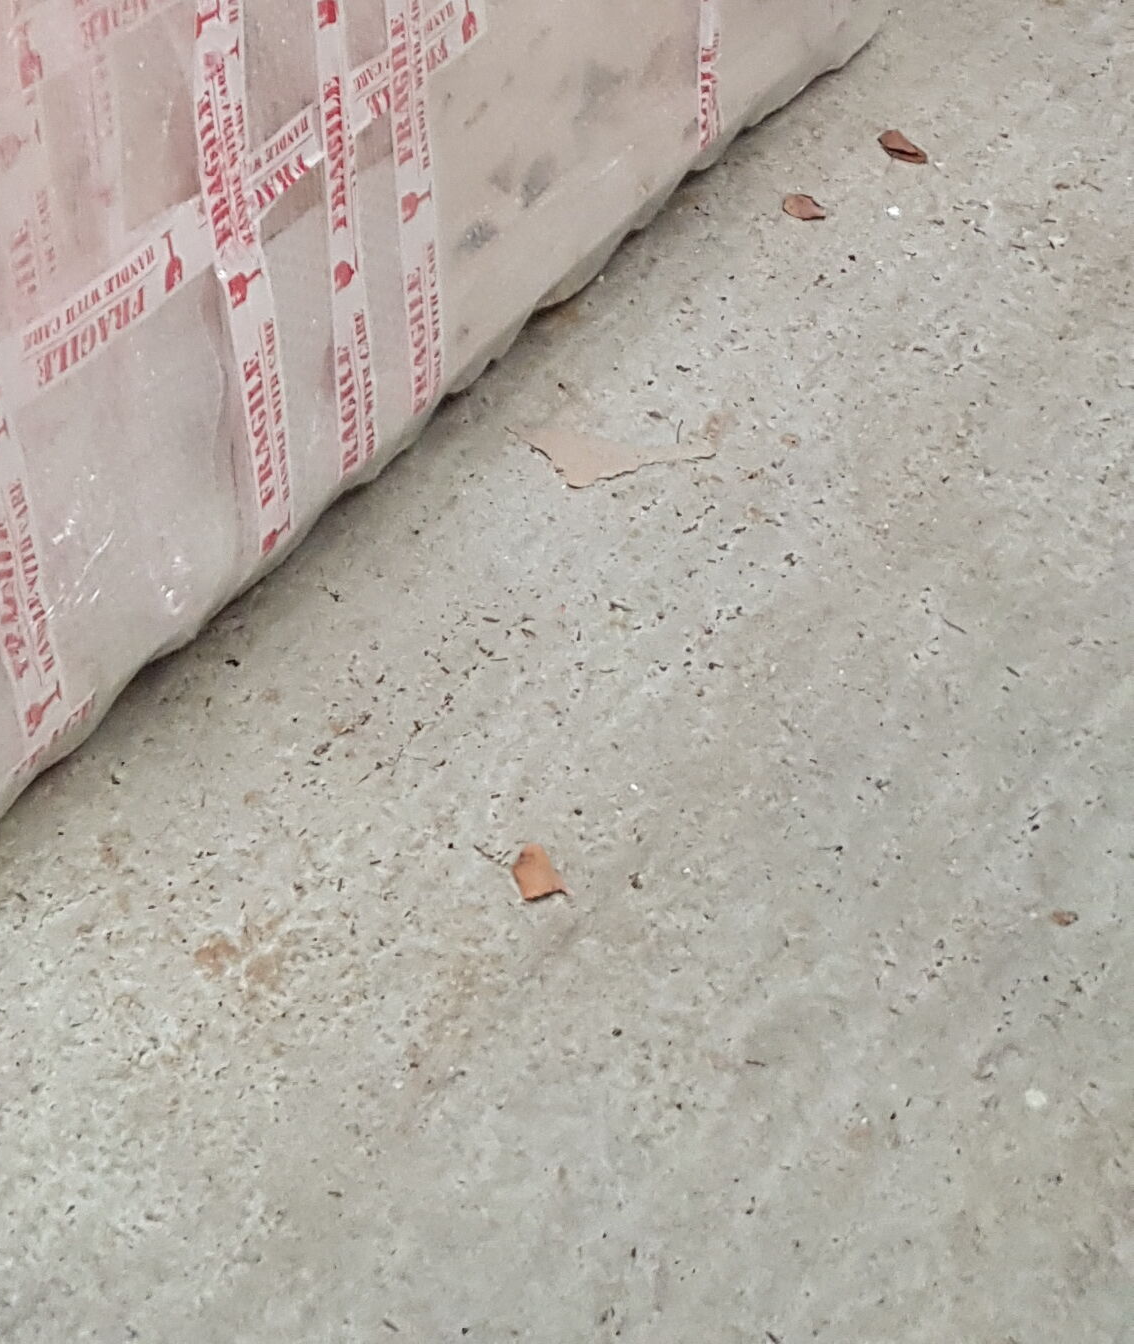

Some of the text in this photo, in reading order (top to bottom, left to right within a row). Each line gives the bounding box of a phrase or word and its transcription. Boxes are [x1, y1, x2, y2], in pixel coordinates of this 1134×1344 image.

[265, 116, 309, 162] HANDLE
[391, 14, 413, 167] FRAGILE
[66, 246, 154, 325] HANDLE WITH
[38, 286, 145, 386] FRAGILE
[243, 351, 275, 509] FRAGILE
